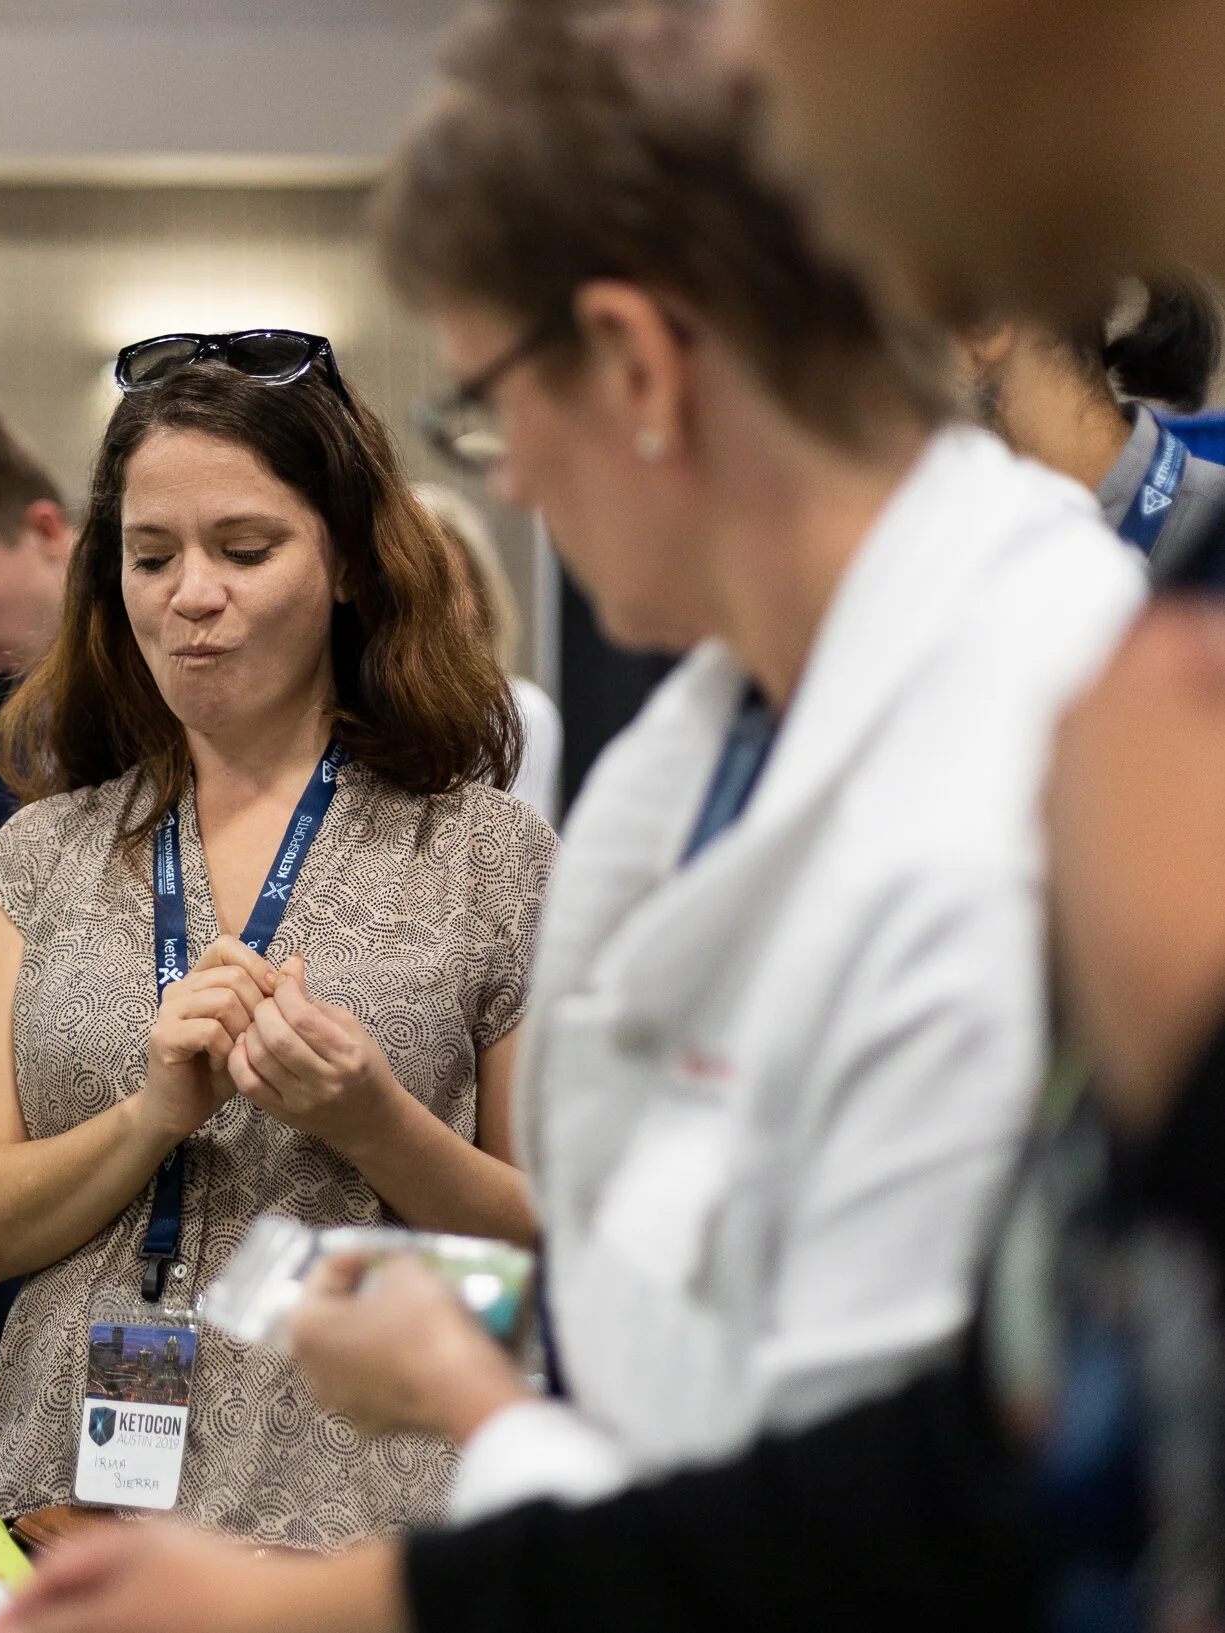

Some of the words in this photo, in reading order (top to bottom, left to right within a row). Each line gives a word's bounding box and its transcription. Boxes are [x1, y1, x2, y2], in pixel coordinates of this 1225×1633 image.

[277, 814, 313, 879] KETOSPORTS
[164, 827, 176, 896] KETOVANGELIST
[164, 938, 178, 967] keto
[119, 1412, 181, 1436] KETOCON
[116, 1433, 153, 1447] AUSTIN
[155, 1435, 180, 1450] 2019
[93, 1454, 126, 1470] IRMA
